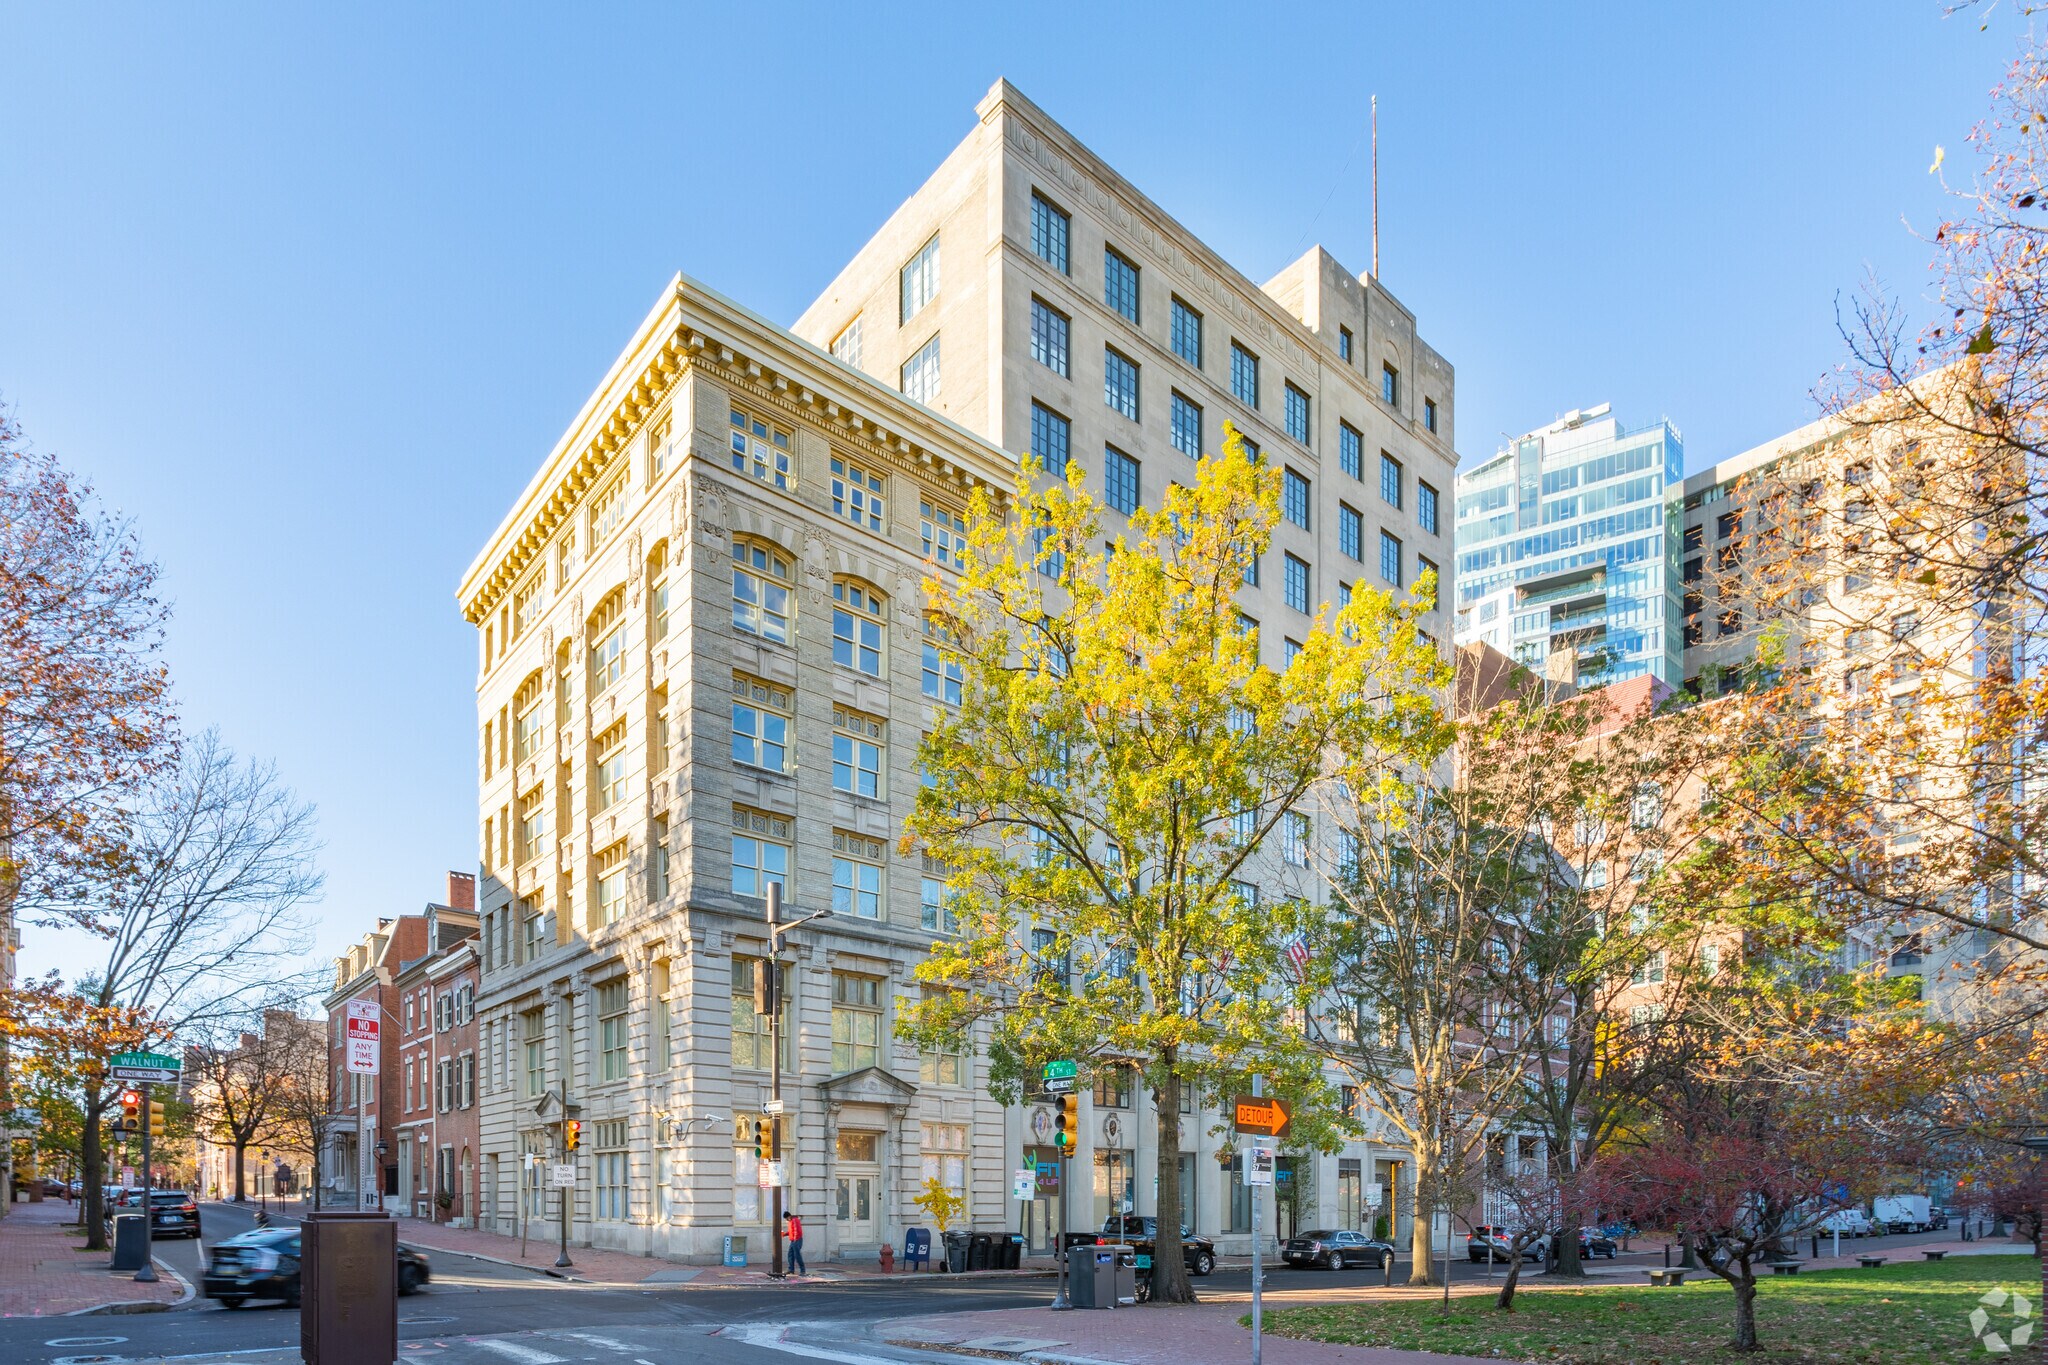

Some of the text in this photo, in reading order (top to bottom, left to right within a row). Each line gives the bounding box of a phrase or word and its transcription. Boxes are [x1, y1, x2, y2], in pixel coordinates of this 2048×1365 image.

[350, 1001, 361, 1009] TOW
[357, 1020, 370, 1031] NO
[349, 1030, 378, 1040] STOPPING
[355, 1042, 373, 1051] ANY
[355, 1051, 373, 1060] TIME
[120, 1057, 165, 1068] WALNUT
[1240, 1107, 1273, 1124] DETOUR
[1037, 1162, 1059, 1178] FIT
[1038, 1178, 1044, 1186] 4
